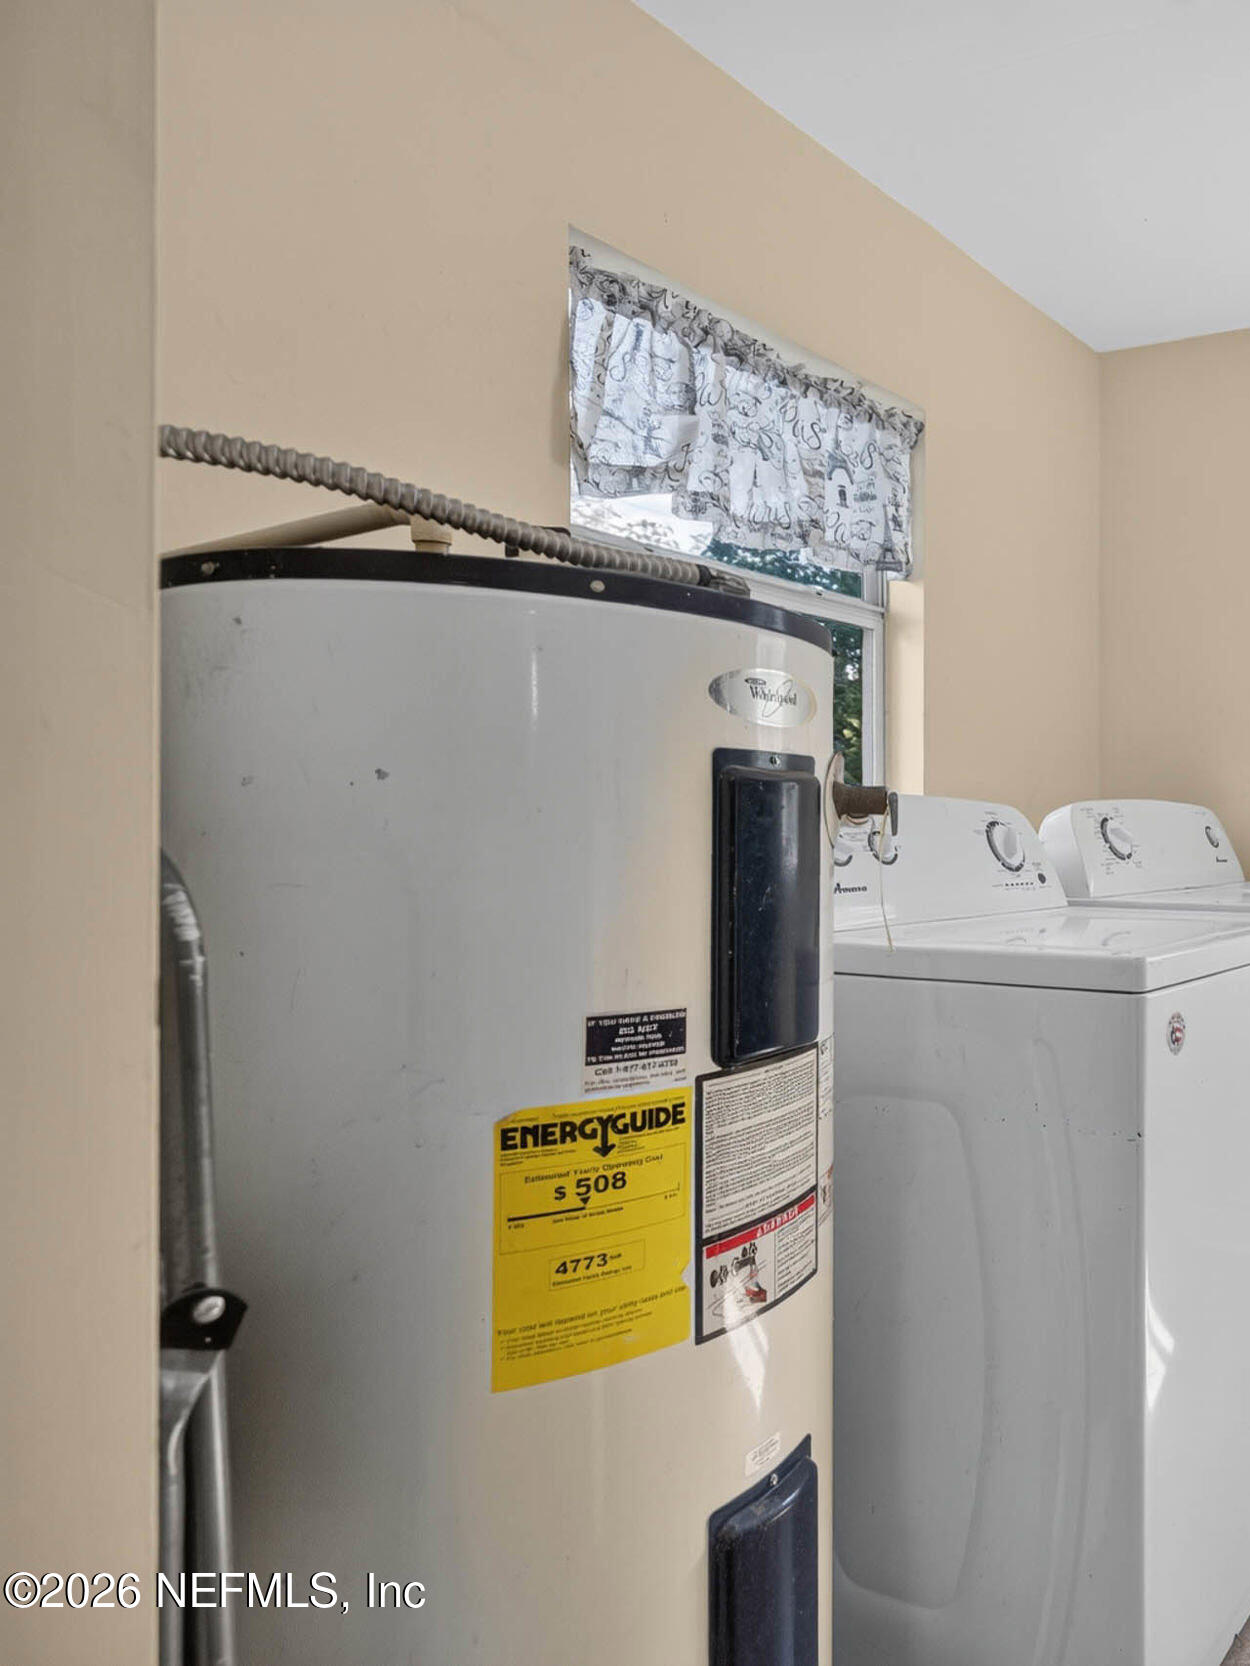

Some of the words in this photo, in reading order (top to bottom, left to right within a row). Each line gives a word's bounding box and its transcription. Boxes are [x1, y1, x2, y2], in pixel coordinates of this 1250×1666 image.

[748, 683, 798, 708] Whirlpool
[500, 1102, 686, 1152] ENERGYGUIDE
[575, 1171, 627, 1197] 508
[555, 1253, 608, 1275] 4773
